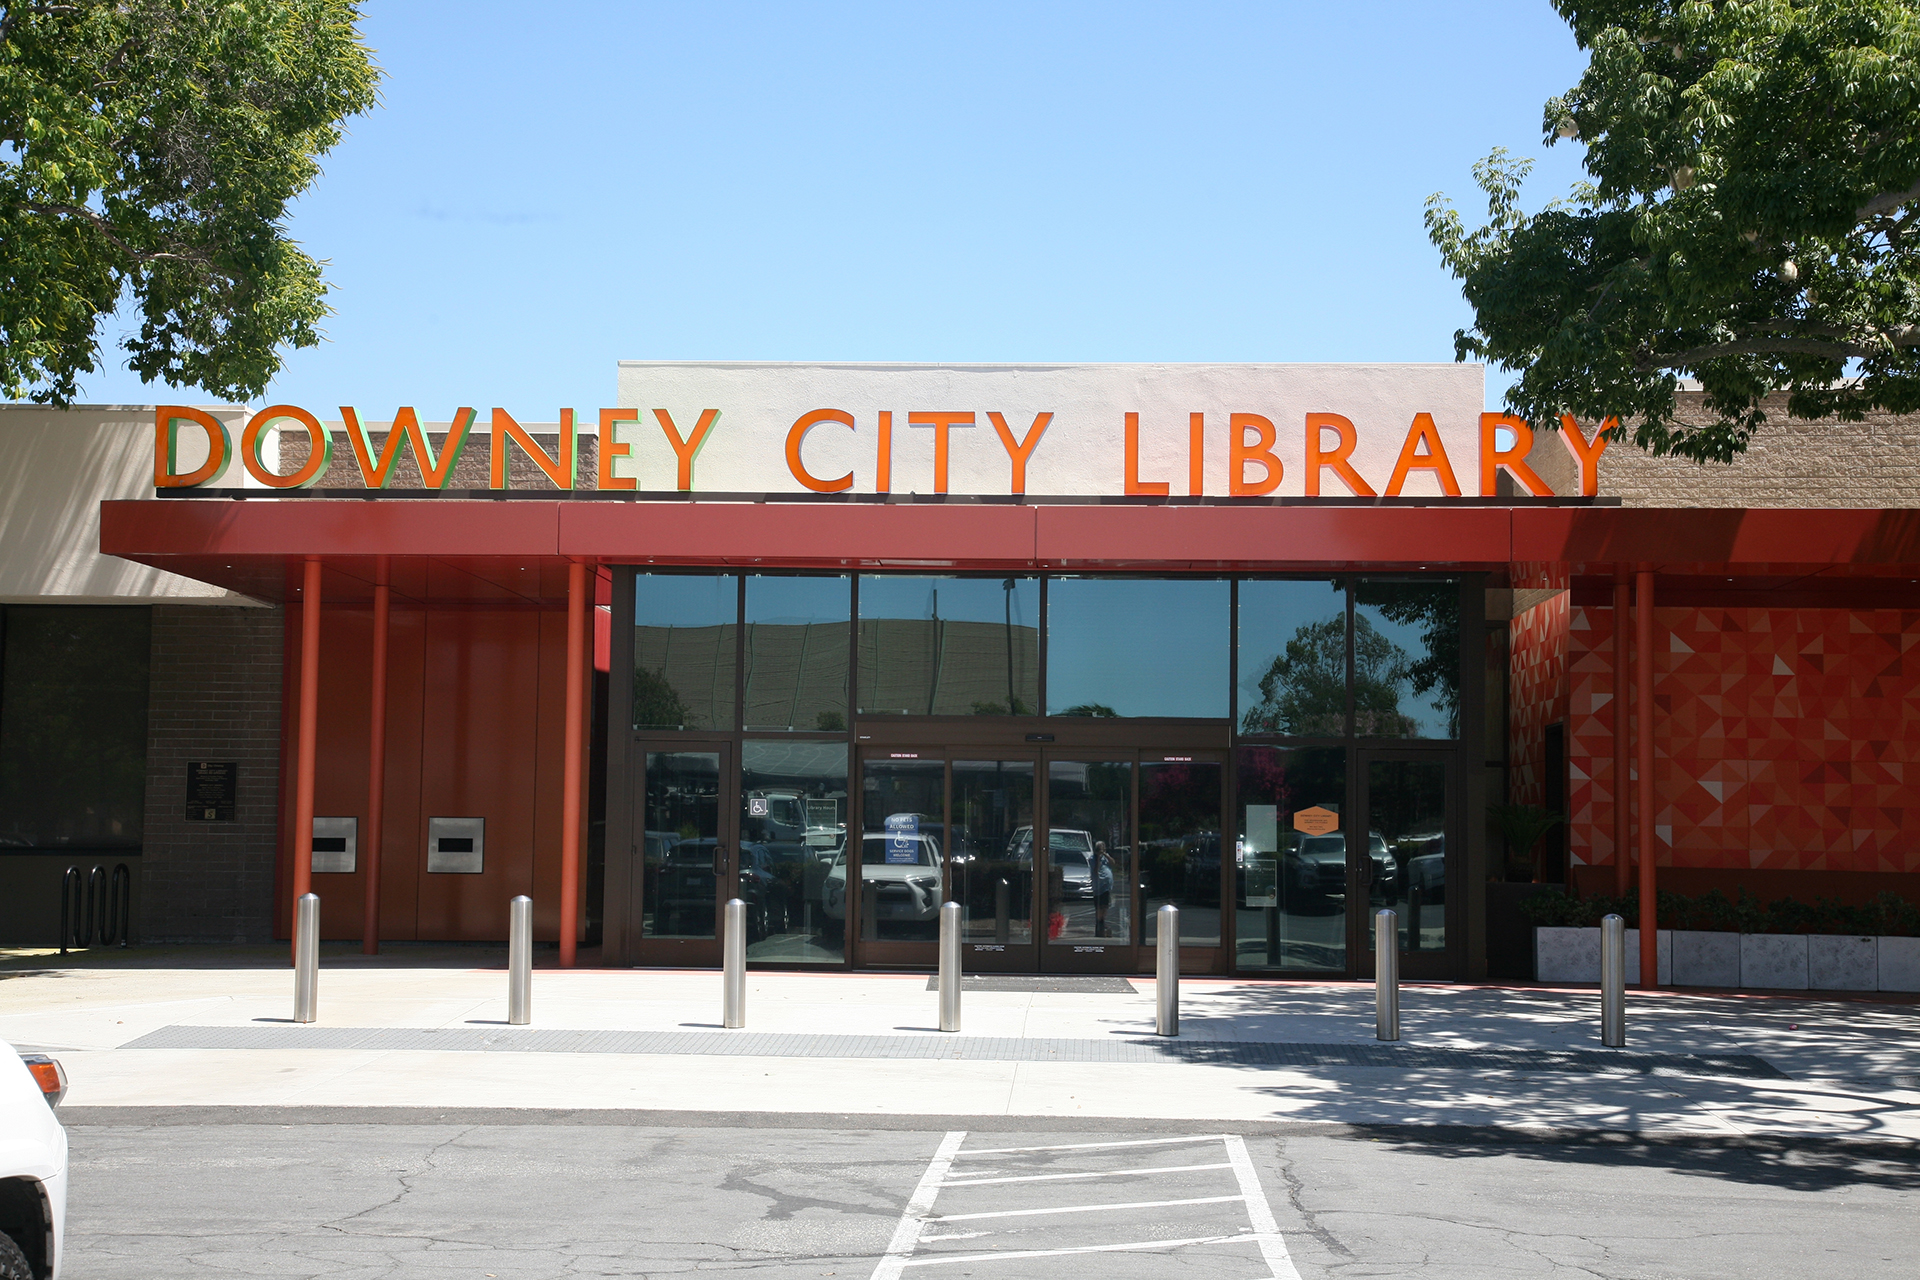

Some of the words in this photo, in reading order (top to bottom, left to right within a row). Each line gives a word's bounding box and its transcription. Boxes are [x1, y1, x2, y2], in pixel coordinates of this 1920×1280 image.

[154, 404, 722, 491] DOWNEY
[785, 409, 1054, 494] CITY
[1124, 412, 1620, 497] LIBRARY
